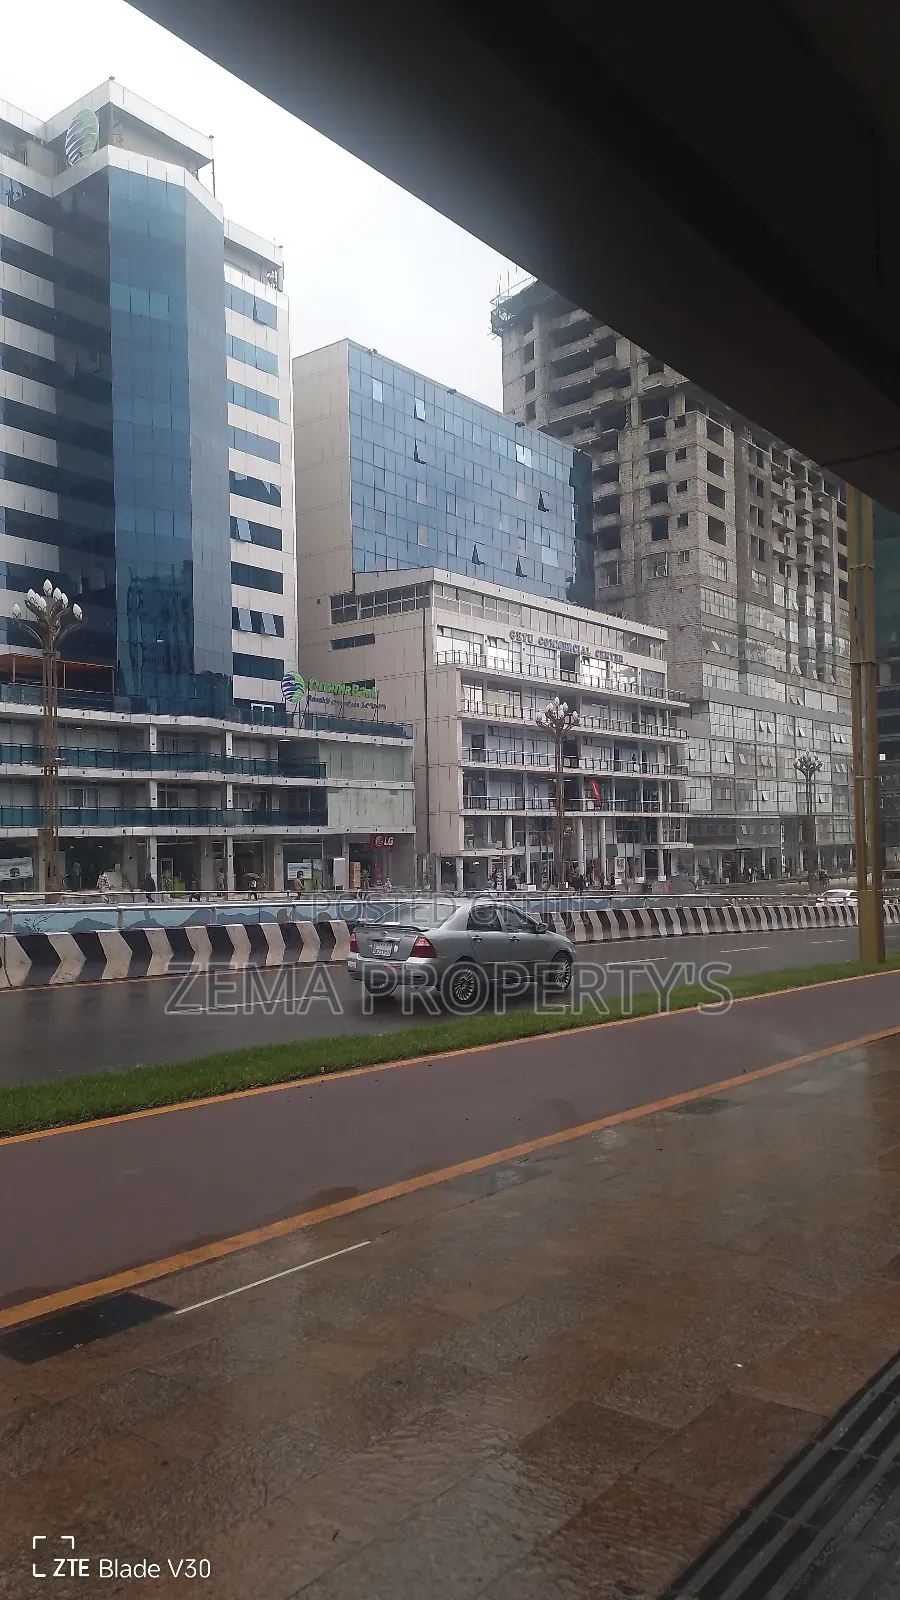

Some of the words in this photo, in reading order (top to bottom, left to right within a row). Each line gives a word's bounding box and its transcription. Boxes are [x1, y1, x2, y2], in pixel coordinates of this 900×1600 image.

[538, 636, 592, 657] COMMERCIAL
[594, 648, 625, 664] CENTER
[383, 836, 394, 846] LG
